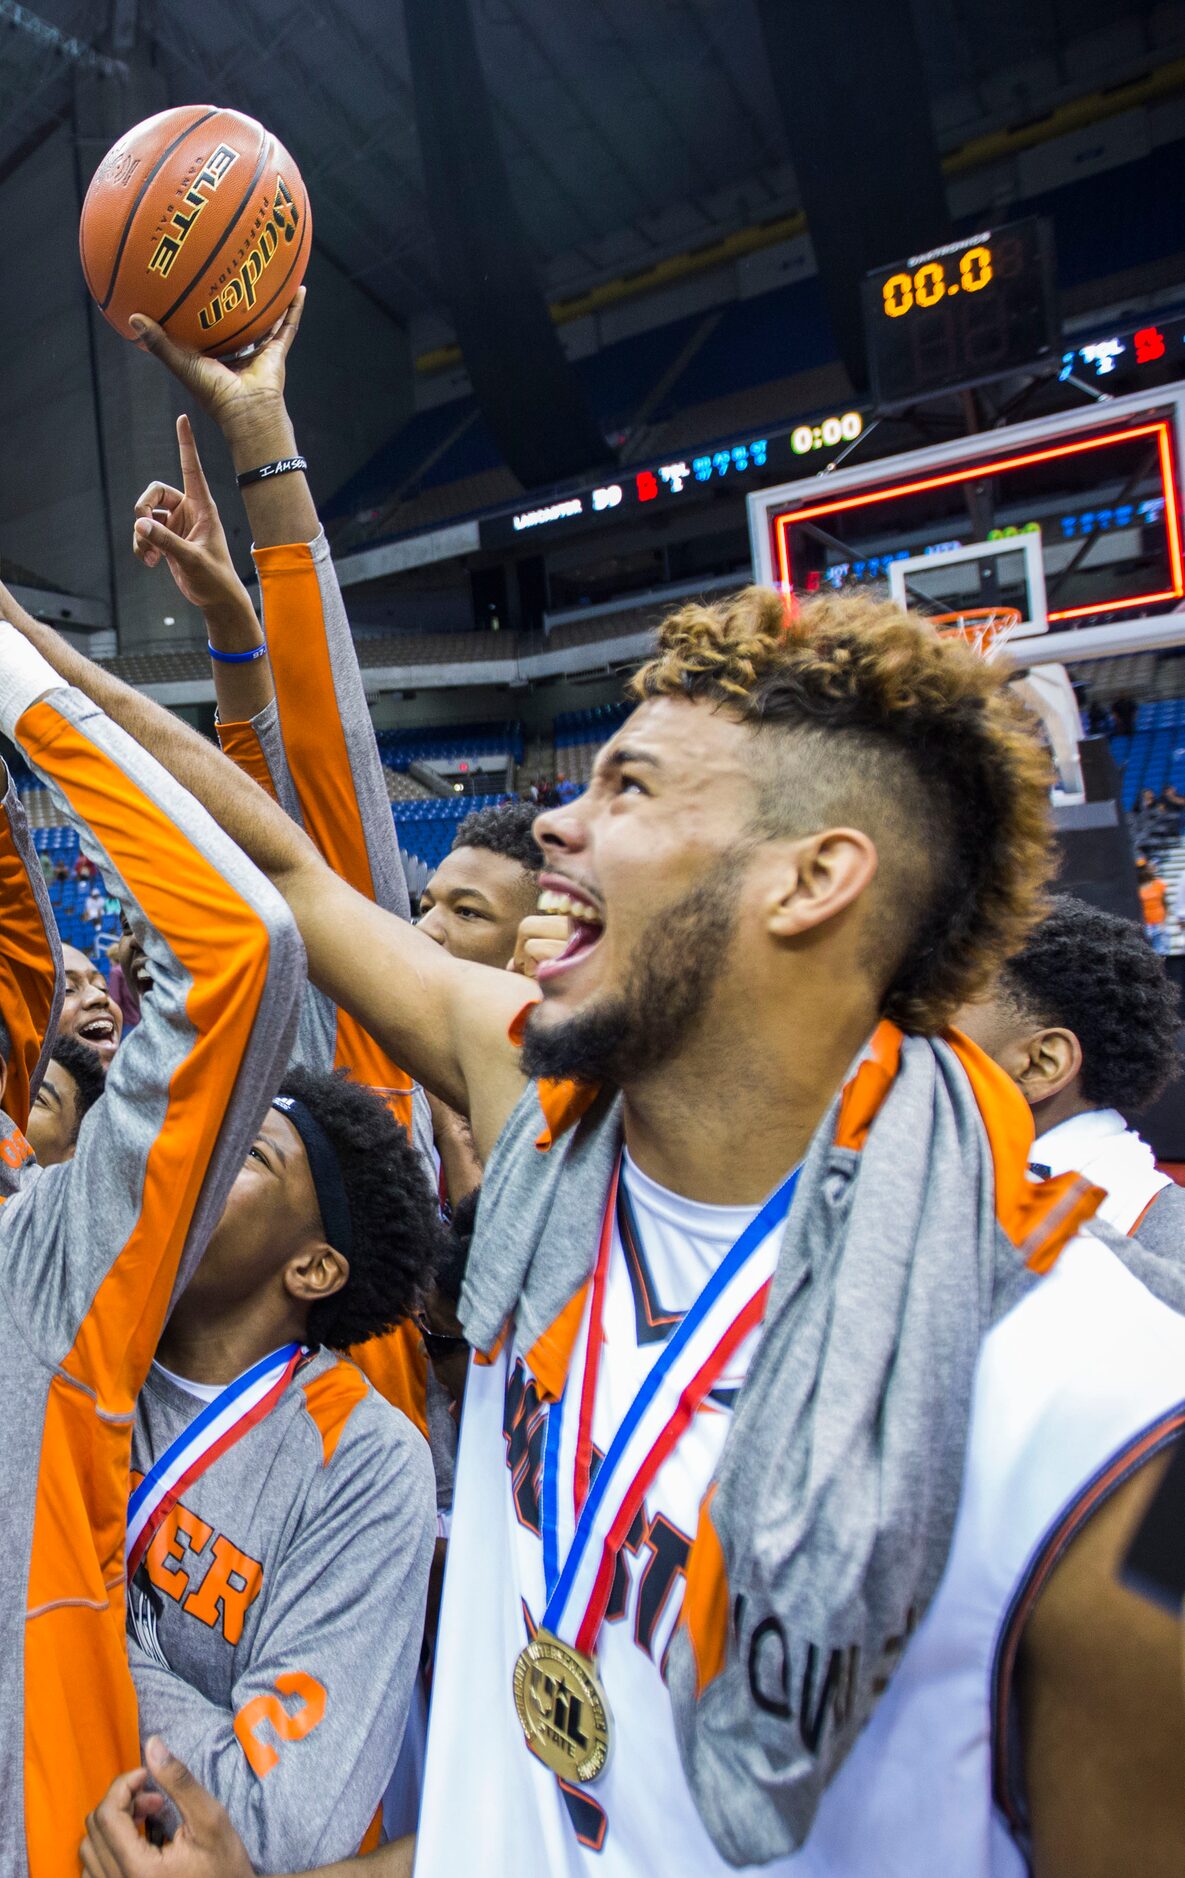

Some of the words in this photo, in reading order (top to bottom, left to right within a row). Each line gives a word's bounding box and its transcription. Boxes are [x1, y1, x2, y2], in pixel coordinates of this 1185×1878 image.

[175, 156, 203, 197] GAME
[148, 142, 241, 279] ELITE
[150, 204, 175, 243] BALL
[197, 174, 301, 331] Baden
[208, 196, 270, 298] PERFECTION
[882, 245, 995, 319] 00.0
[790, 409, 864, 455] 0:00
[259, 464, 275, 478] I
[233, 1670, 328, 1781] 2
[537, 1721, 577, 1760] STATE
